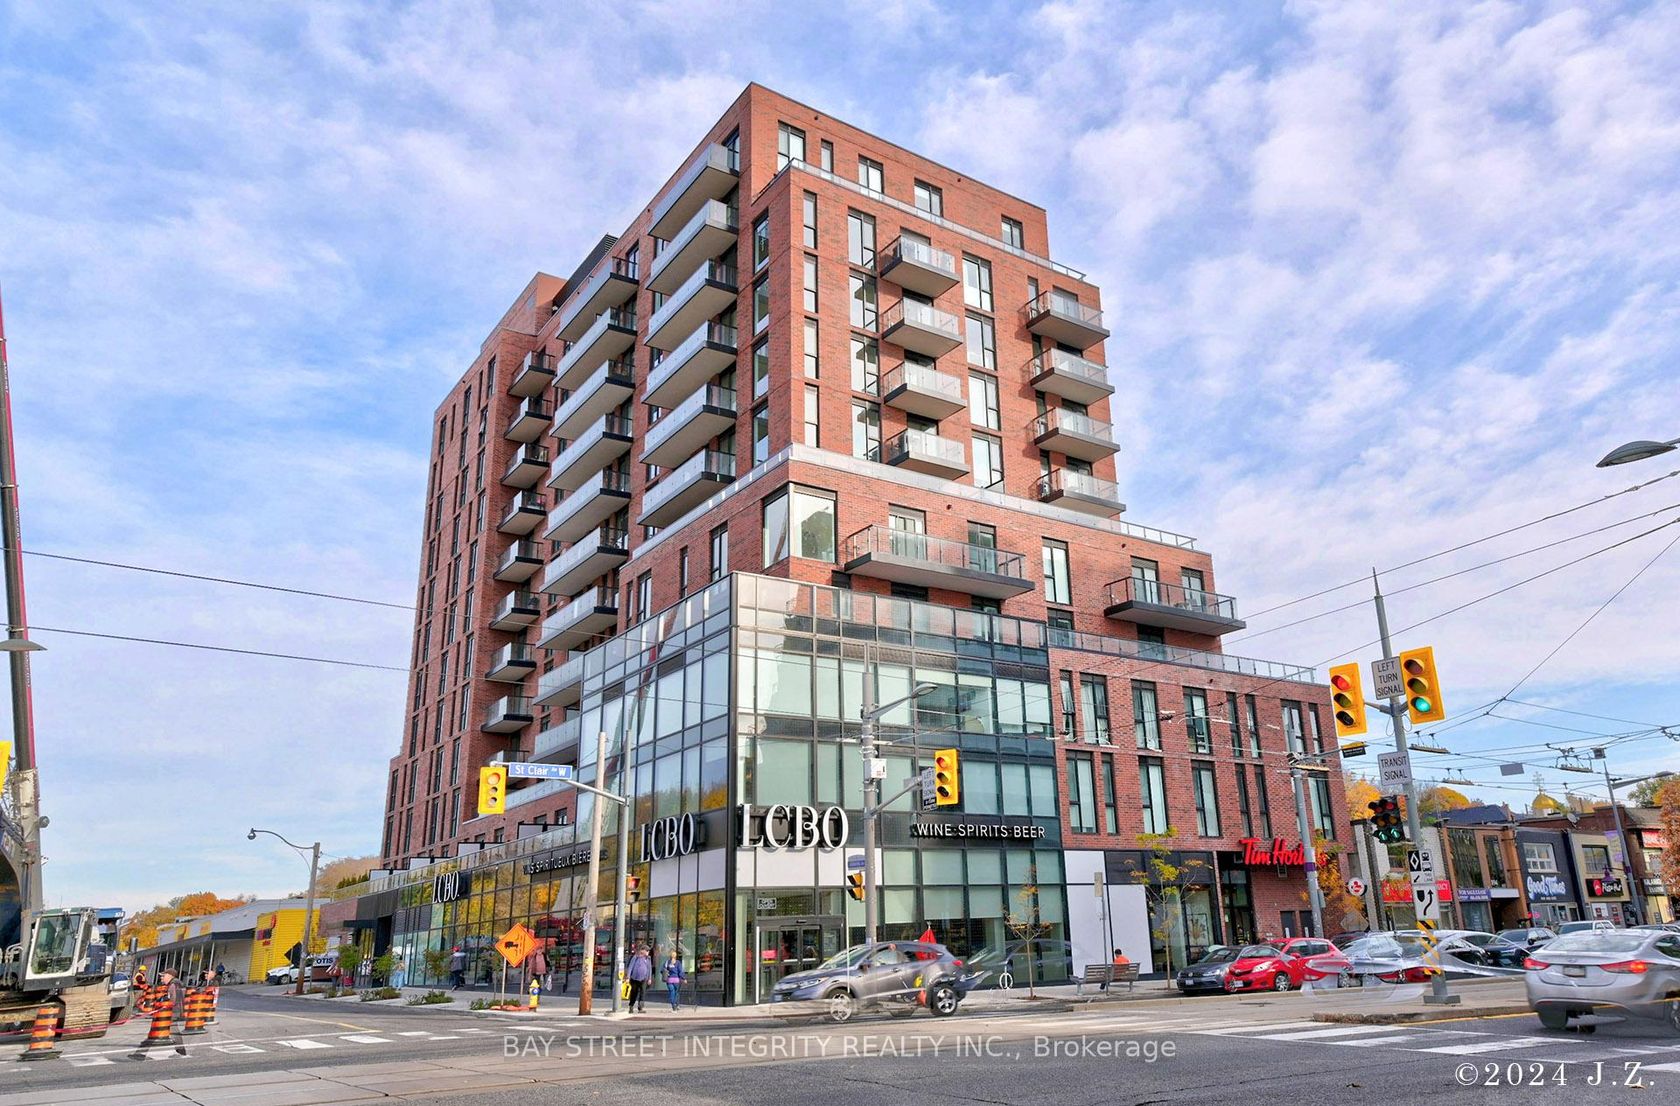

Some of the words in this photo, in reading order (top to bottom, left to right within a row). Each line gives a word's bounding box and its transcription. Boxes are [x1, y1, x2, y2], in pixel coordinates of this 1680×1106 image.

[1377, 661, 1396, 672] LEFT
[1378, 672, 1398, 684] TURN
[1377, 684, 1404, 697] SIGNAL
[1381, 756, 1407, 768] TRANSIT
[515, 765, 525, 775] St
[528, 765, 549, 775] Clair
[558, 767, 567, 777] W
[1384, 769, 1408, 781] SIGNAL
[741, 803, 849, 849] LCBO
[916, 823, 952, 837] WINE
[958, 823, 1008, 838] SPIRITS
[1013, 825, 1046, 838] BEER
[640, 811, 695, 863] LCBO
[1239, 837, 1271, 865] Tim
[432, 870, 460, 904] LCBO
[1527, 874, 1549, 900] Good
